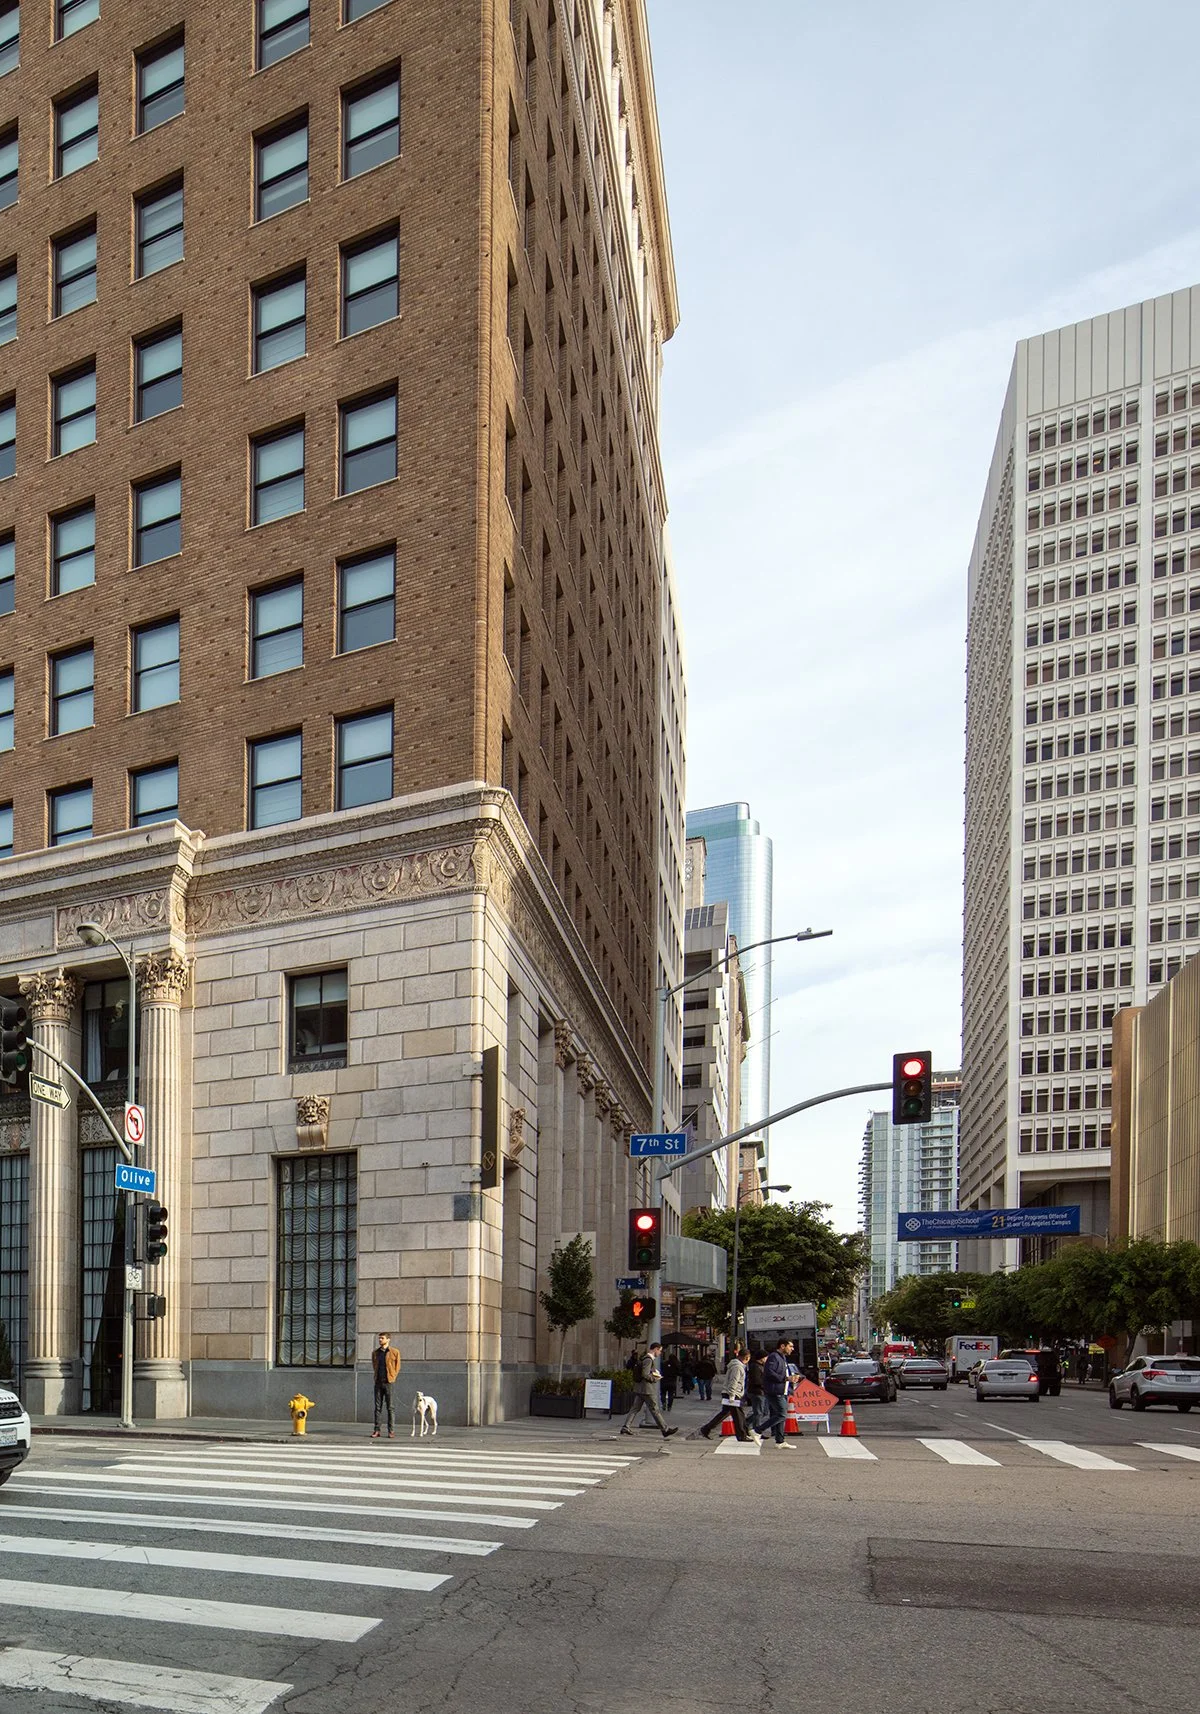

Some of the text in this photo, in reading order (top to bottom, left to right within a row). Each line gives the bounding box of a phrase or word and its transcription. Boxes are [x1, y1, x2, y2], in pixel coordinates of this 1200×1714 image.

[636, 1138, 680, 1152] 7th St
[121, 1169, 151, 1186] Olive
[991, 1215, 1005, 1228] 21
[959, 1341, 991, 1351] FedEx
[796, 1390, 821, 1399] LANE
[797, 1399, 832, 1408] LOSED
